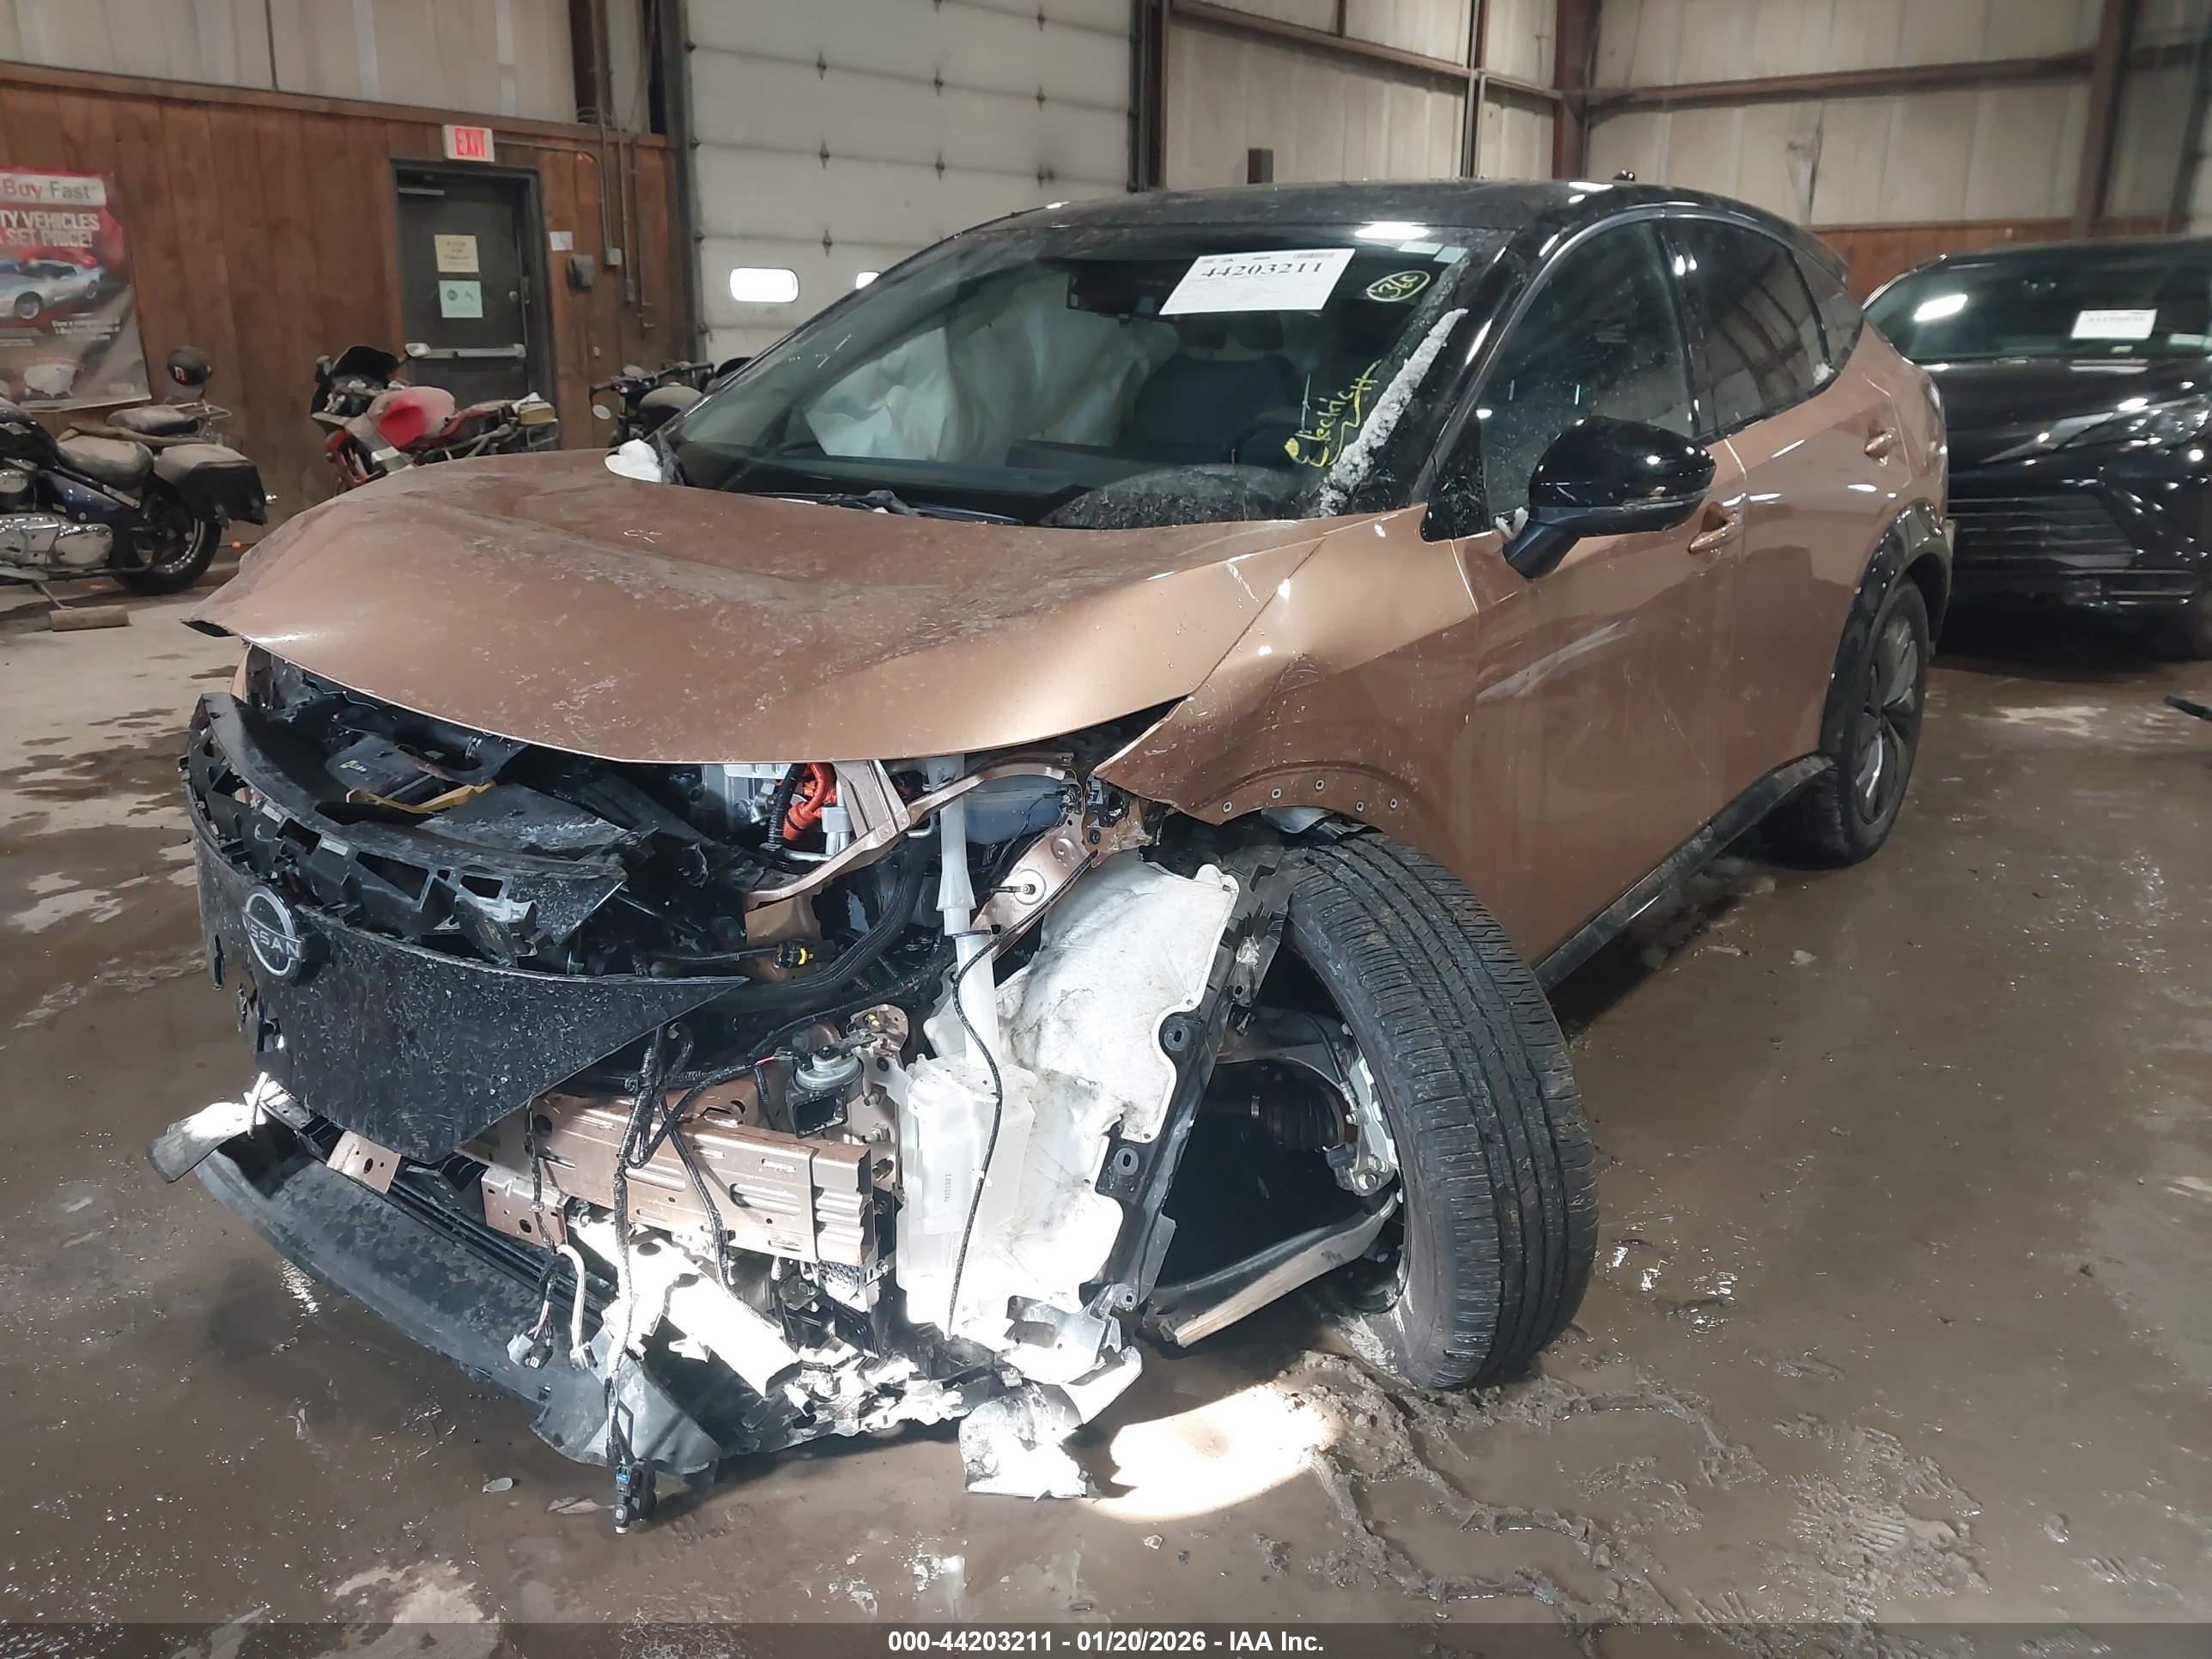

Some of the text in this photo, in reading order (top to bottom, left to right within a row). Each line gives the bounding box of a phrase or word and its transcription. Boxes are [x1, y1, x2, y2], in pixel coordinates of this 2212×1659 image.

[49, 180, 91, 200] Fast
[20, 211, 100, 231] VEHICLES
[1202, 261, 1324, 277] 44203211
